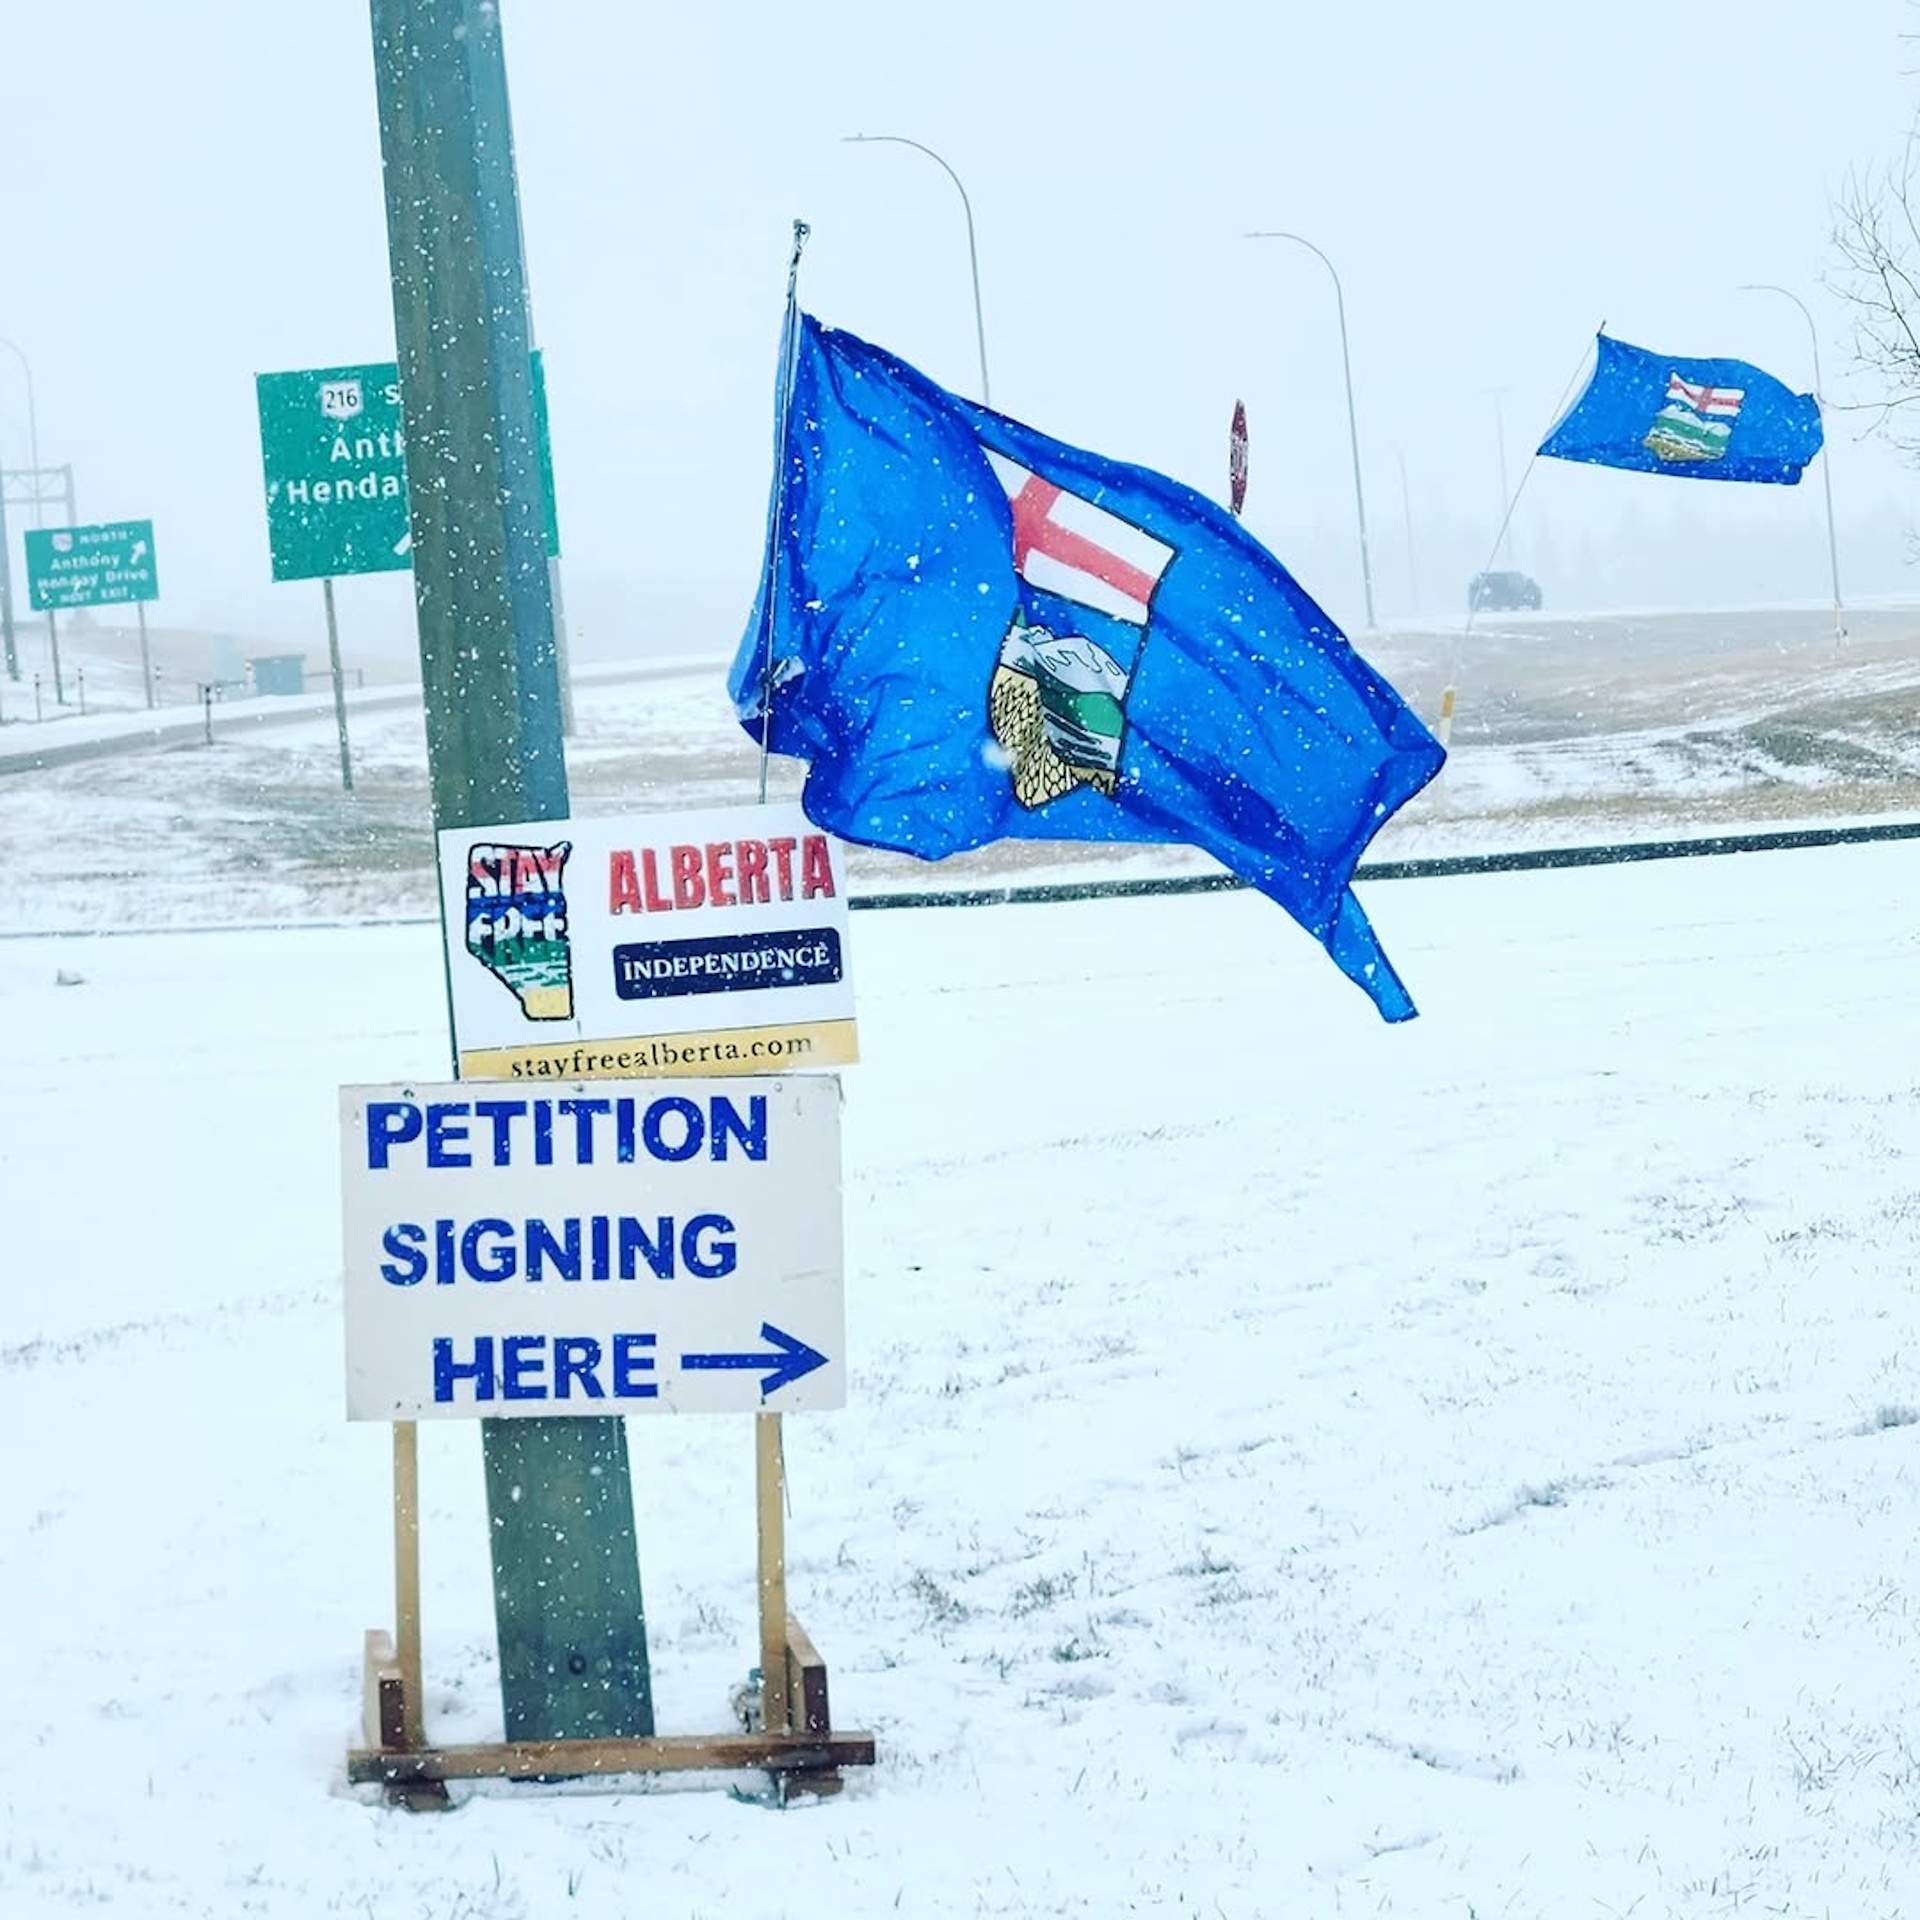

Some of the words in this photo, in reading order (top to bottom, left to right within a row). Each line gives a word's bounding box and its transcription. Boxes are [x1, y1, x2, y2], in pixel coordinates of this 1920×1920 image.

[326, 389, 357, 409] 216
[287, 471, 400, 505] Henda
[50, 553, 120, 571] Anthony
[105, 568, 149, 583] Drive
[467, 842, 572, 898] STAY
[609, 834, 837, 916] ALBERTA
[624, 943, 830, 981] INDEPENDENCE
[511, 1035, 812, 1078] stayfreealberta.com
[367, 1095, 768, 1170] PETITION
[380, 1214, 737, 1287] SIGNING
[433, 1333, 659, 1402] HERE
